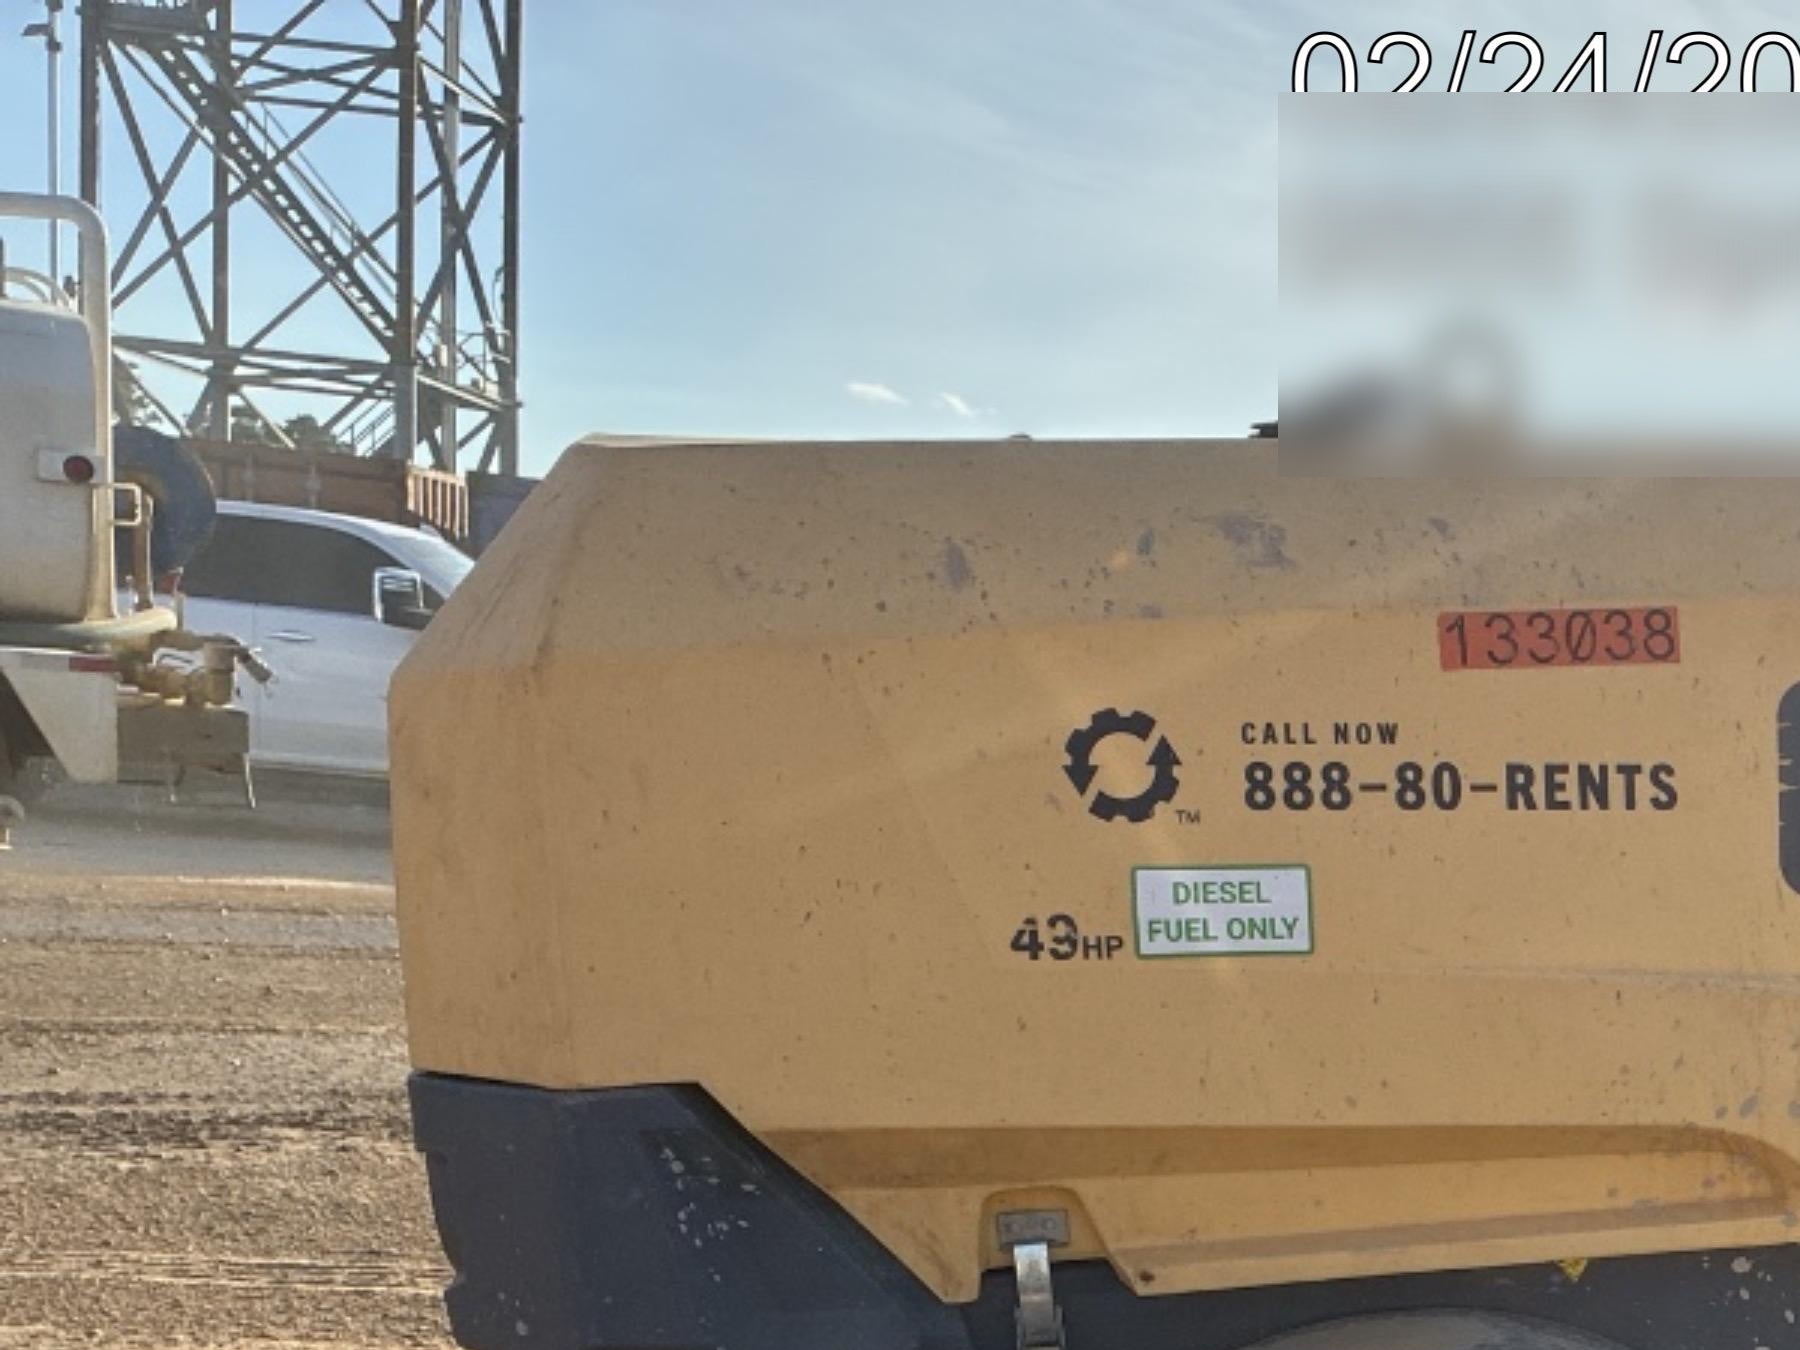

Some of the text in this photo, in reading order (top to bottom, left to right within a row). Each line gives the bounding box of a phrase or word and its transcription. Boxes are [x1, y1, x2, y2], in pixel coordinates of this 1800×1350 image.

[1444, 607, 1677, 666] 133038
[1240, 721, 1399, 745] CALL NOW
[1244, 760, 1679, 812] 888-80-RENTS
[1172, 880, 1272, 905] DIESEL
[1147, 916, 1300, 943] FUEL ONLY
